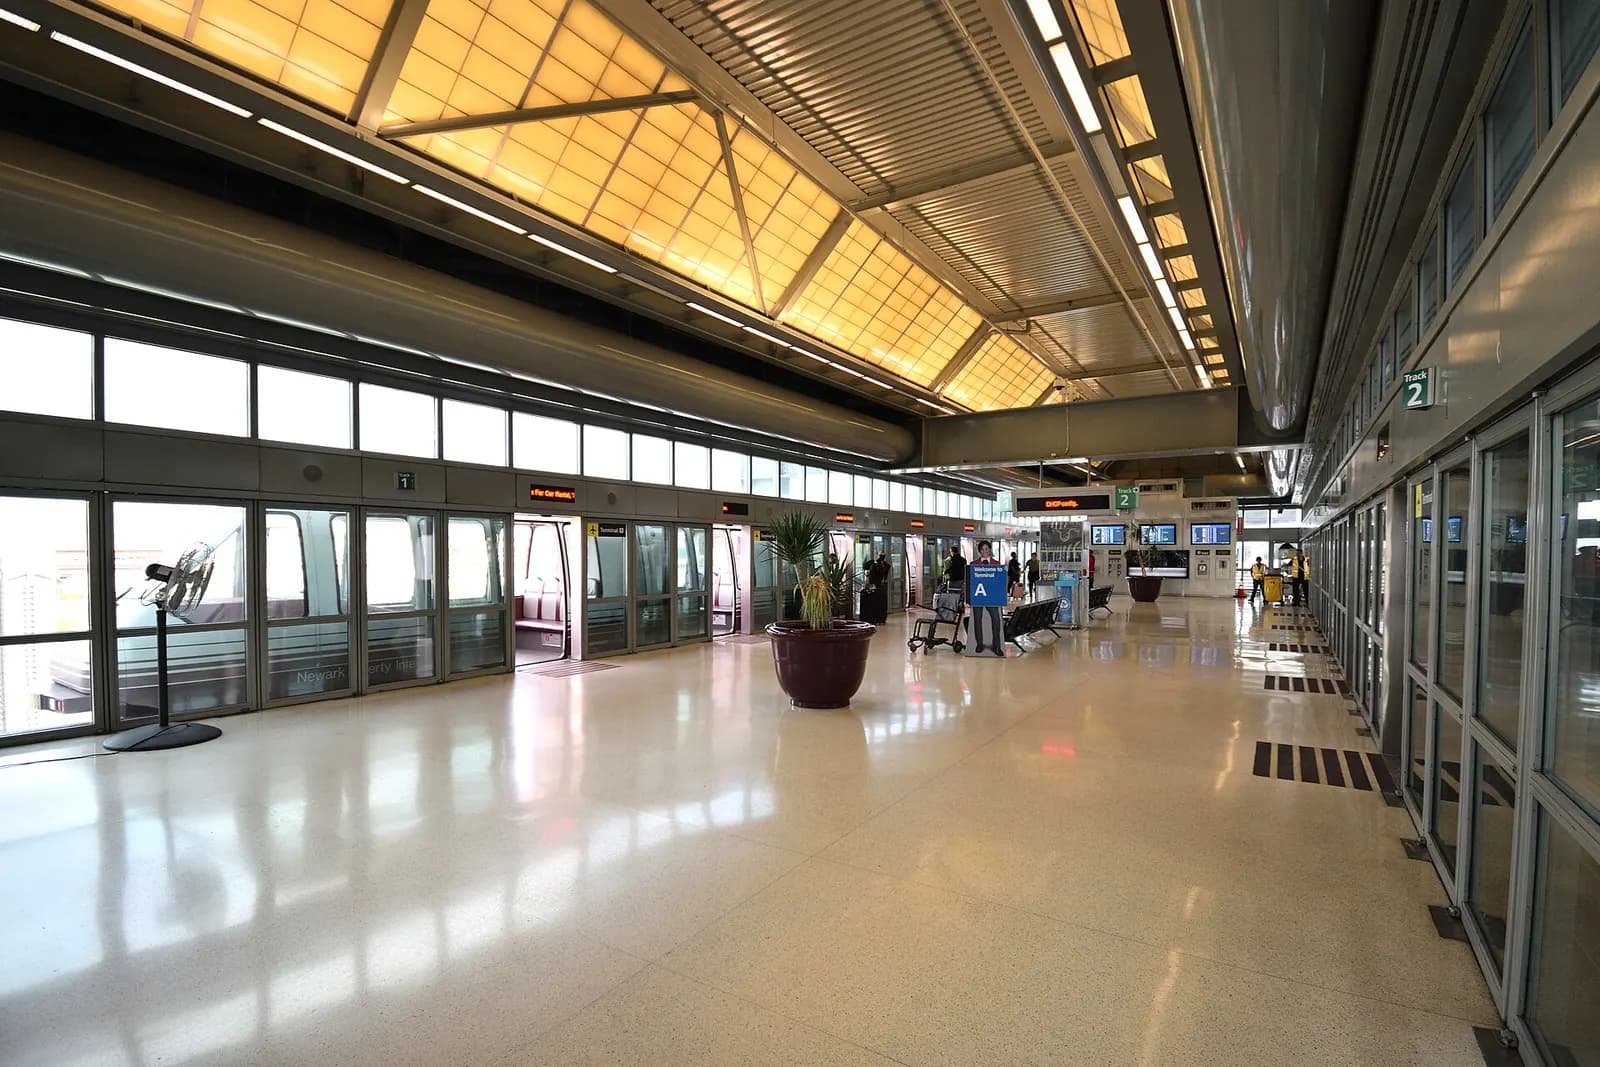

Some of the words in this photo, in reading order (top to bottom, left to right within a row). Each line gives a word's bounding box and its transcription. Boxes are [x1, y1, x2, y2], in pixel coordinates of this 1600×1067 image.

[1403, 371, 1427, 382] Track
[1407, 383, 1422, 406] 2
[401, 478, 407, 488] 1
[1120, 495, 1129, 506] 2
[974, 583, 987, 597] A
[297, 667, 345, 682] Newark
